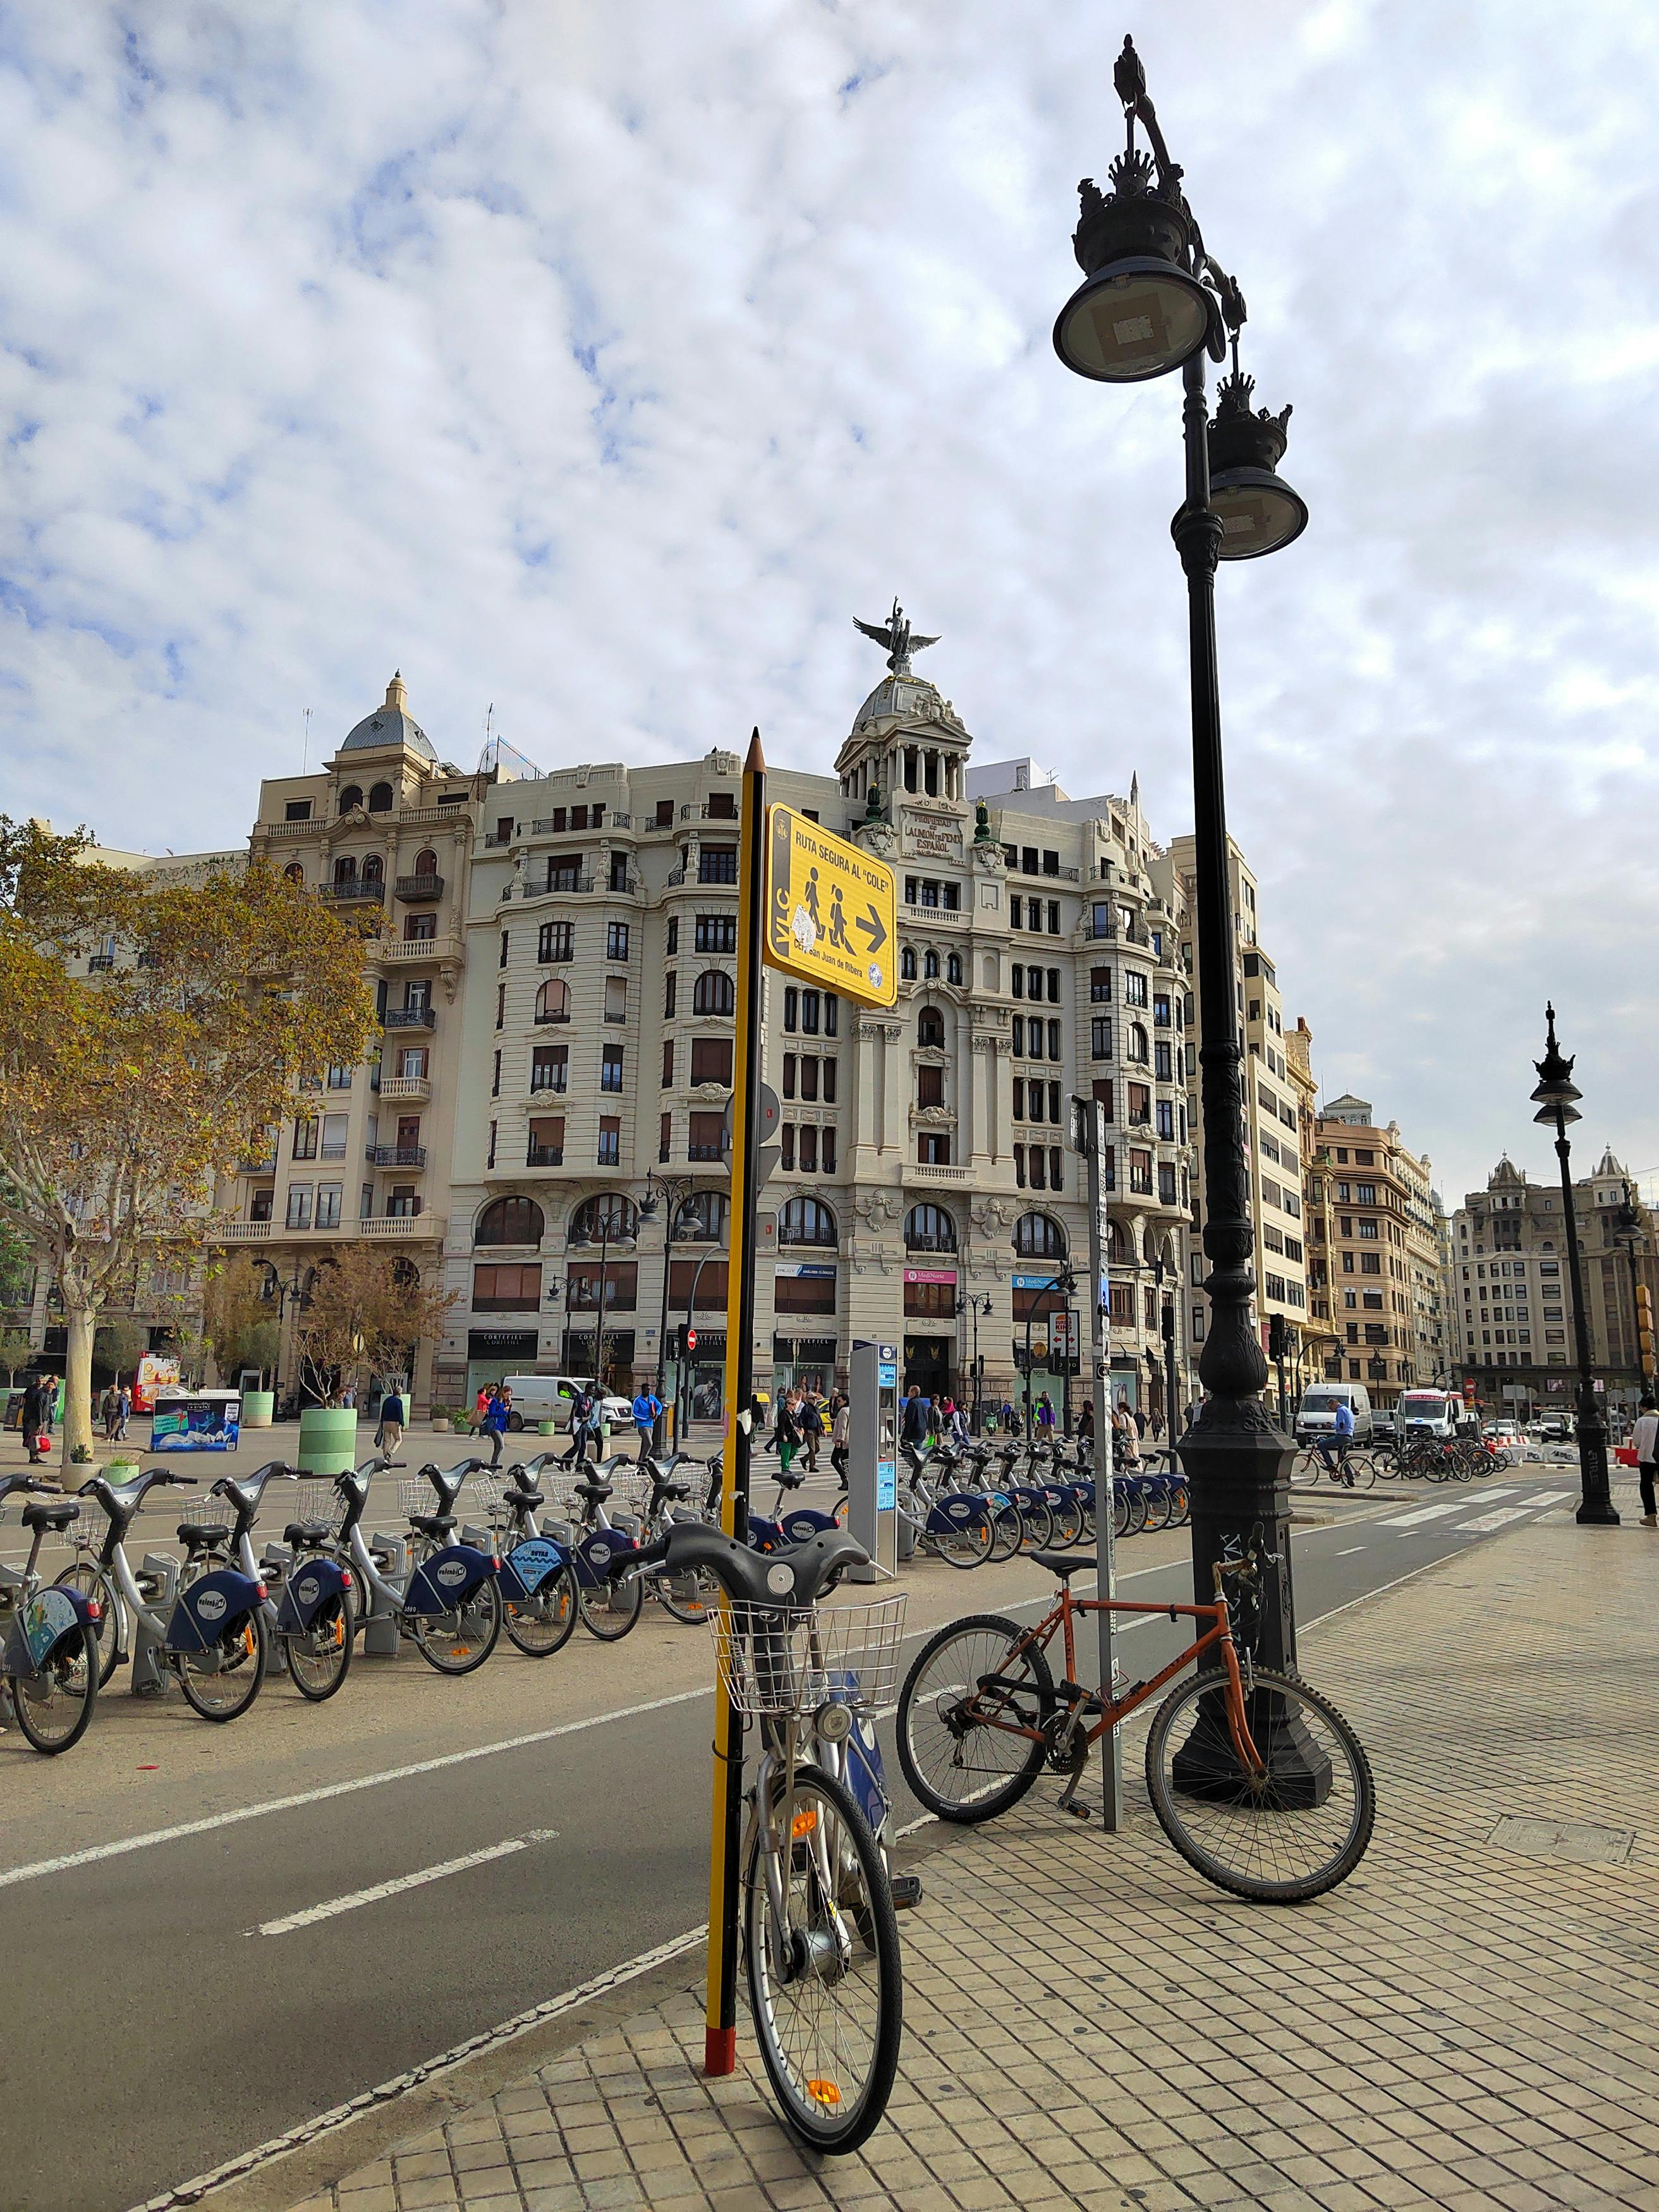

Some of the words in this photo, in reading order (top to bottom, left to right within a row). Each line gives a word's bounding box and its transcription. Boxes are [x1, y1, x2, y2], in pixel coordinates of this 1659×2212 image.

[915, 815, 951, 827] PROPIEDAD
[906, 825, 915, 836] LA
[915, 827, 935, 841] UNION
[796, 830, 817, 856] RUTA
[818, 844, 850, 874] SEGURA
[851, 866, 861, 880] AL
[917, 839, 950, 852] ESPAÑOL
[775, 887, 791, 944] VLC
[822, 951, 836, 966] Juan
[837, 958, 844, 969] de
[845, 961, 863, 978] Ribera
